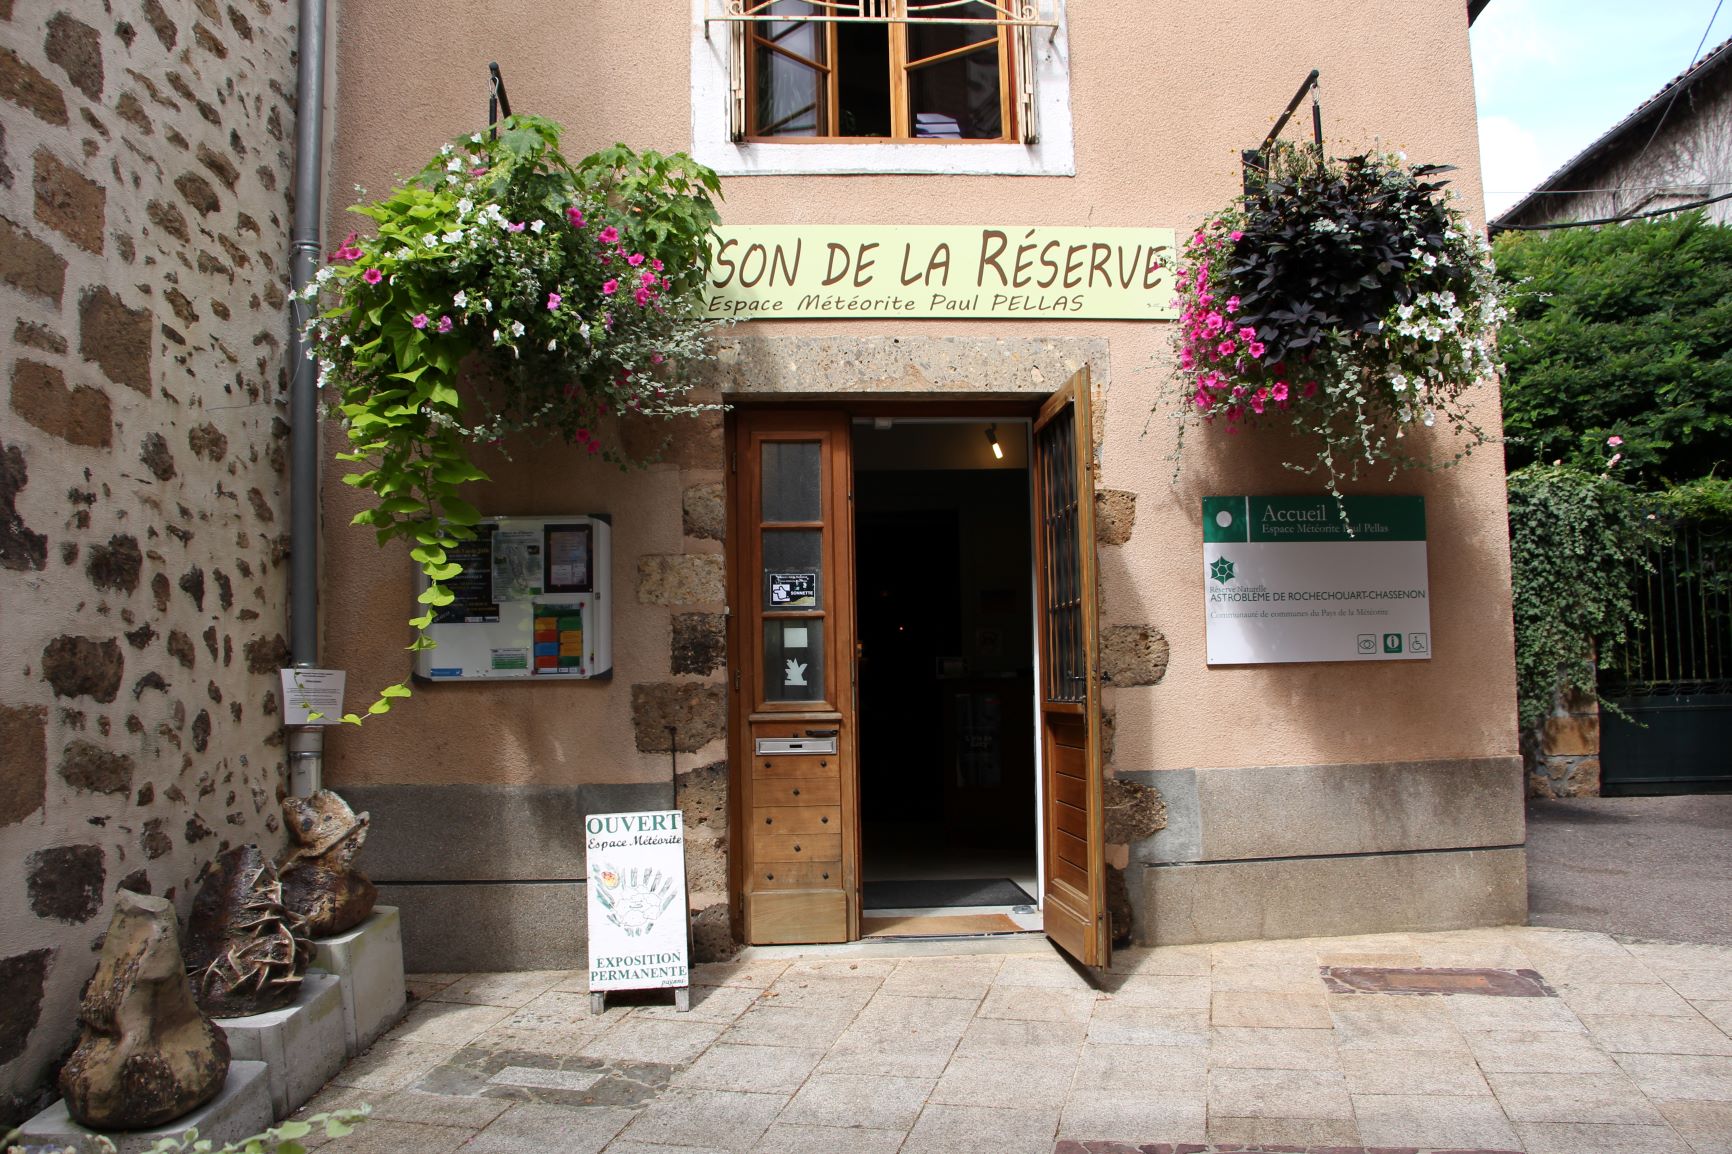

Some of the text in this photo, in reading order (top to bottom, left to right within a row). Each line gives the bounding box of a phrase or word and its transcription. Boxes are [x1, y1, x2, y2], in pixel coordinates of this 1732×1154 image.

[821, 242, 880, 288] DE
[900, 242, 950, 287] LA
[977, 228, 1167, 290] RÉSERVE
[708, 293, 1084, 316] Espace Météorite Paul PELLAS
[1261, 504, 1327, 522] Accueil
[1261, 522, 1389, 536] Espace Météorite Pul Pellas
[1237, 585, 1267, 593] Naturelle
[1272, 592, 1286, 601] DE
[1288, 590, 1426, 601] ROCHECHOUART-CHASSENON
[1260, 610, 1269, 618] de
[1310, 609, 1319, 617] du
[1321, 609, 1337, 618] Pays
[1338, 608, 1347, 616] de
[1348, 608, 1355, 616] la
[587, 813, 681, 835] OUVERT
[588, 835, 682, 851] Espace Météorite
[597, 952, 681, 969] EXPOSITION
[591, 965, 687, 982] PERMANENTE
